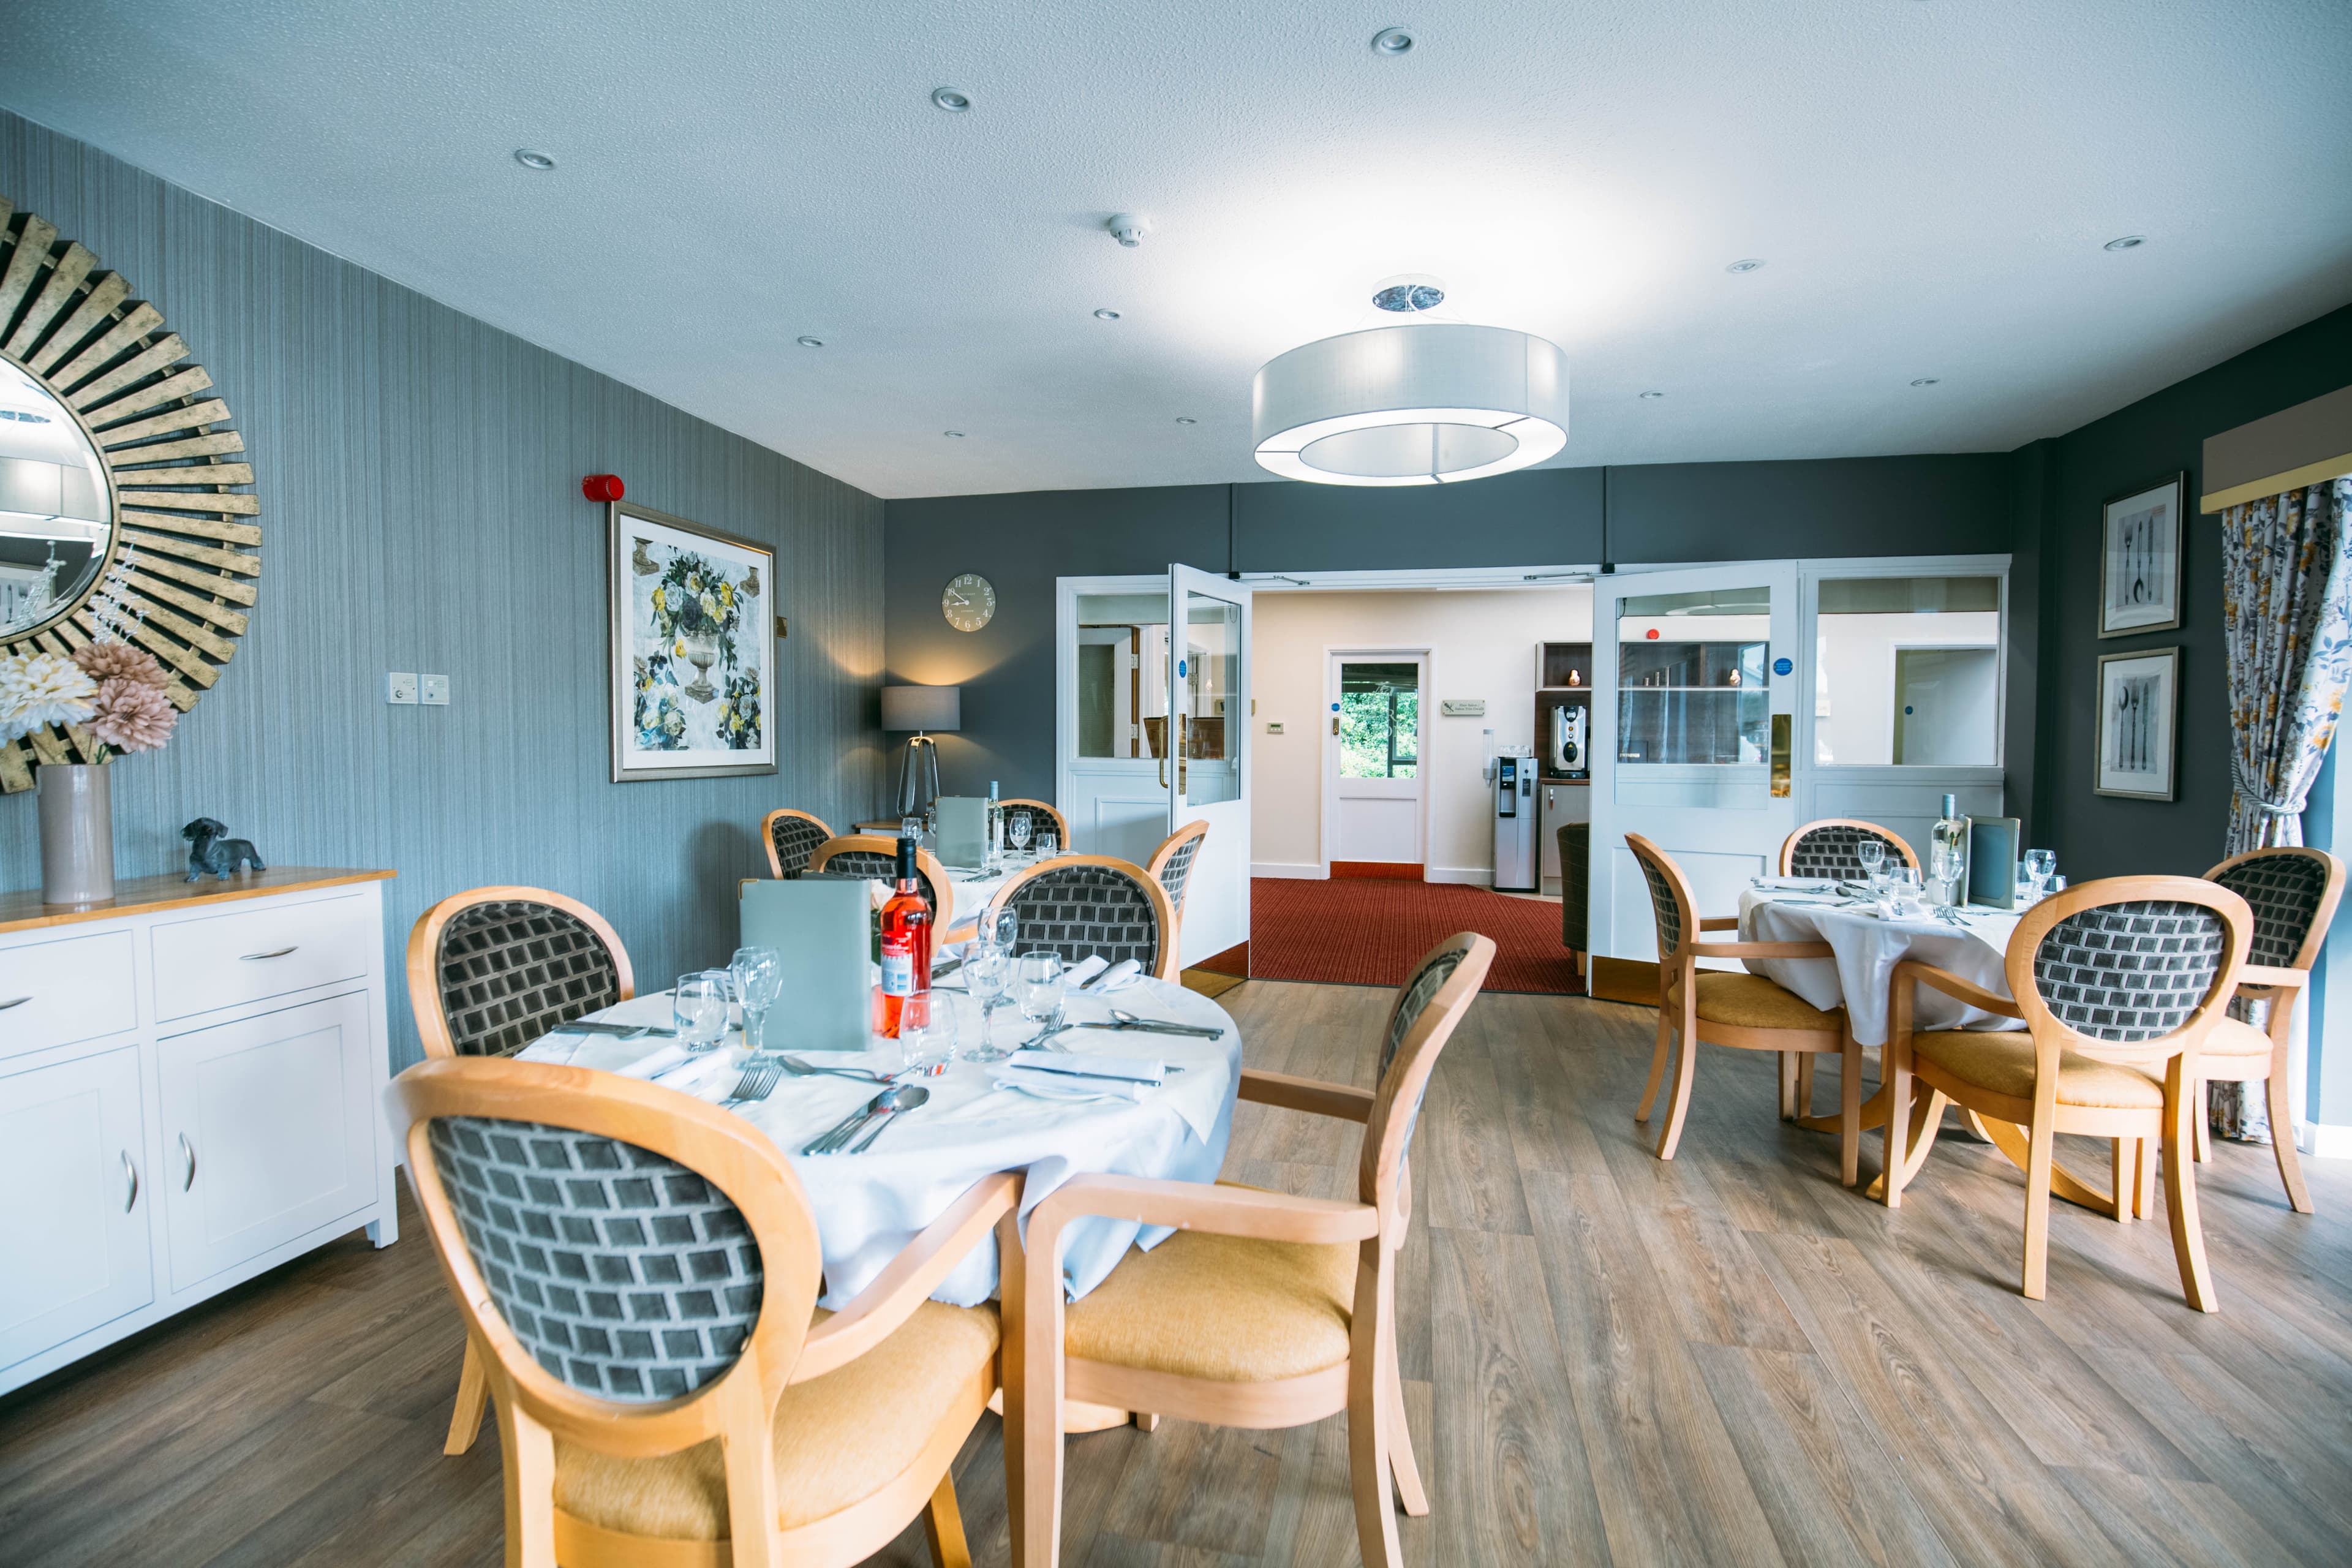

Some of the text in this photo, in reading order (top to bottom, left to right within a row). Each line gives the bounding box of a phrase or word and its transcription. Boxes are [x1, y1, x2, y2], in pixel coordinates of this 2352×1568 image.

[944, 598, 949, 607] 9
[987, 598, 992, 606] 3
[983, 609, 988, 617] 4
